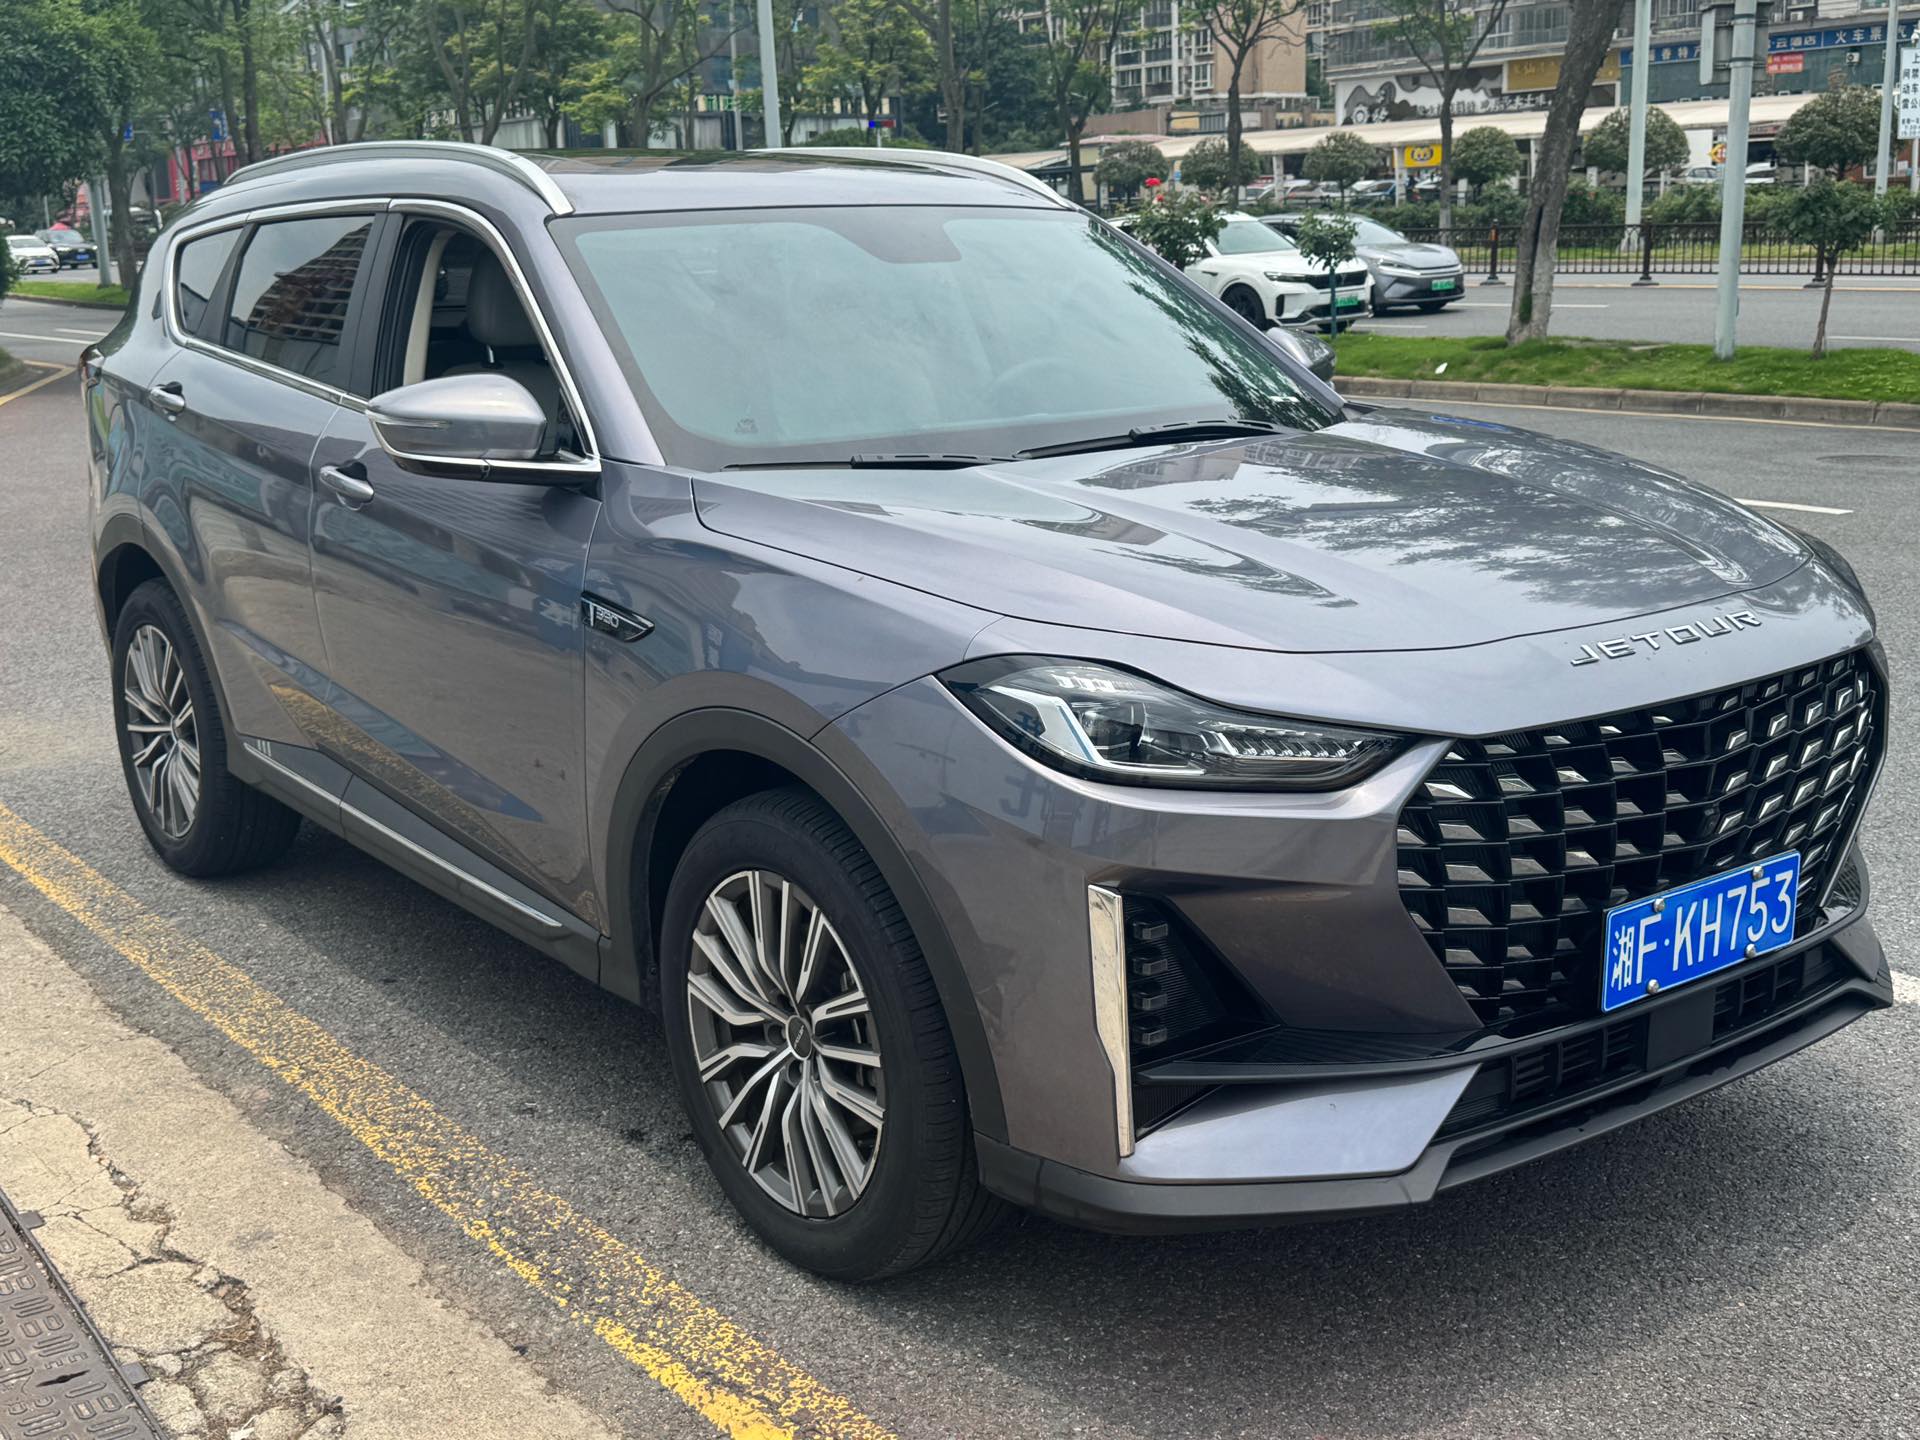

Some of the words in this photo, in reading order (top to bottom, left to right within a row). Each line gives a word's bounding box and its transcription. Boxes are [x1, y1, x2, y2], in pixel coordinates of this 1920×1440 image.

[1835, 26, 1882, 44] 火车票
[1570, 610, 1762, 667] JETOUR
